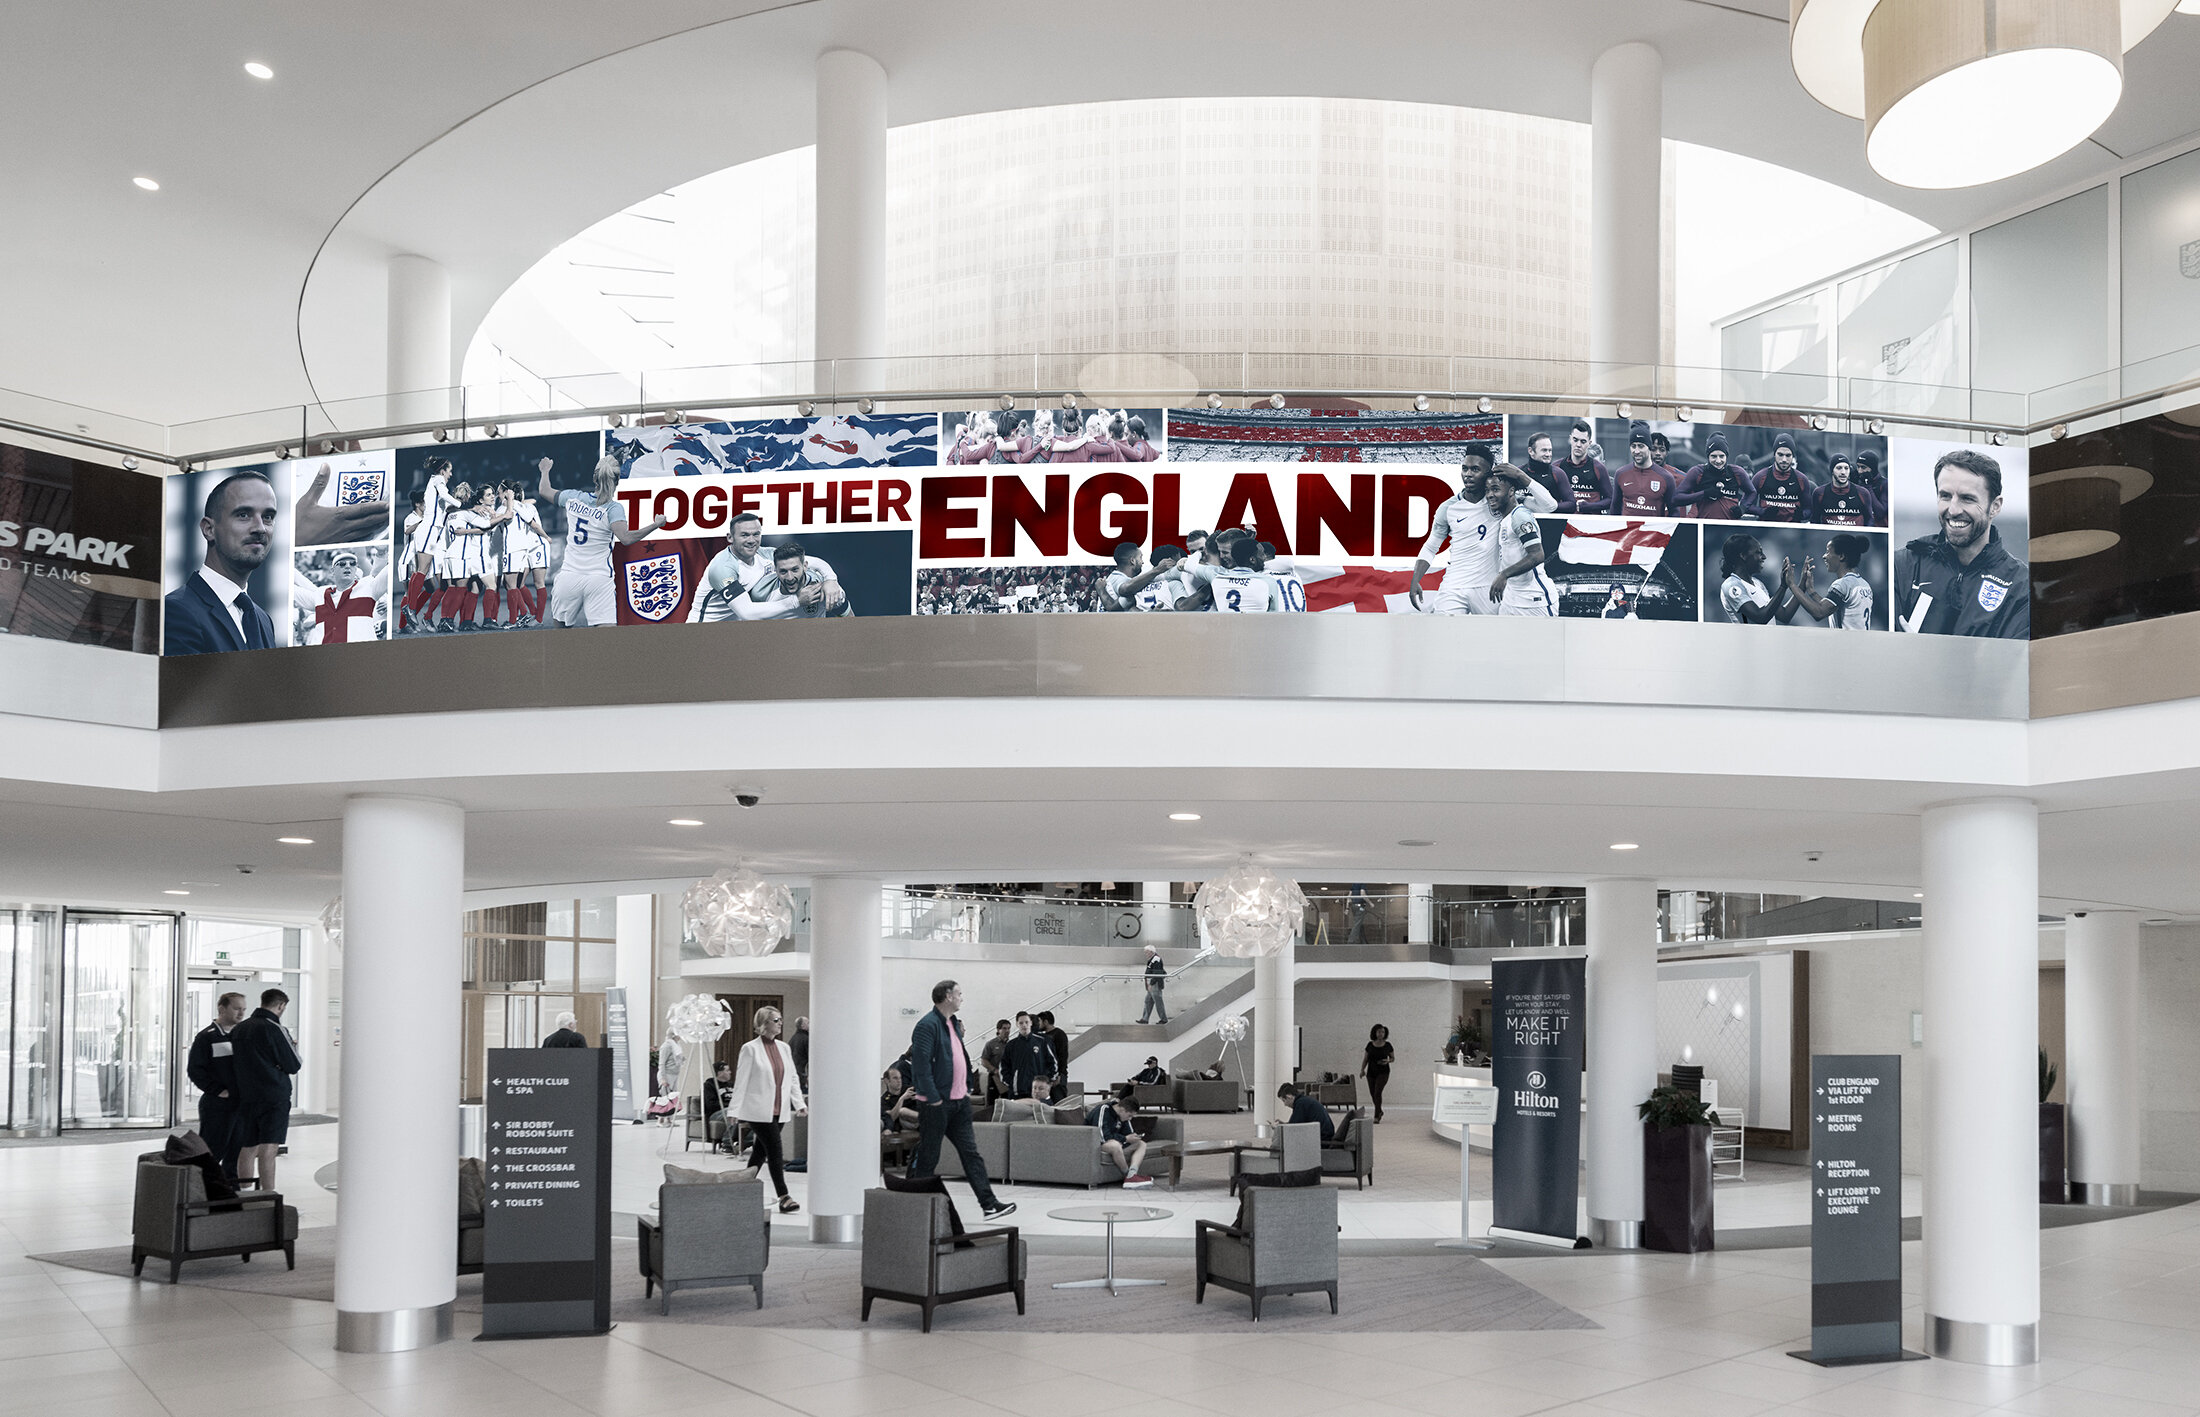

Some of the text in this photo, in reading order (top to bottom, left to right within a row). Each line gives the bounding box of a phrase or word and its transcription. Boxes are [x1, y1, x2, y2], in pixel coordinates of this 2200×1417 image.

[1626, 502, 1657, 511] VAUXHALL
[618, 472, 1454, 559] TOGETHER ENGLAND
[574, 517, 588, 545] 5
[1478, 524, 1487, 540] 9
[24, 527, 134, 569] PARK
[536, 552, 542, 561] 9
[20, 561, 92, 585] TEAMS
[723, 588, 732, 599] C
[1276, 579, 1306, 612] 10
[1034, 919, 1065, 927] CENTRE
[1036, 927, 1063, 935] CIRCLE
[1506, 1017, 1569, 1031] MAKE IT
[1515, 1031, 1560, 1045] RIGHT
[506, 1078, 570, 1086] HEALTH CLUB
[1828, 1078, 1880, 1086] CLUB ENGLAND
[506, 1087, 534, 1095] & SPA
[1828, 1086, 1872, 1095] VIA LIFT ON
[1514, 1090, 1559, 1109] Hilton
[1828, 1096, 1864, 1104] 1st FLOOR
[1828, 1114, 1863, 1123] MEETING
[506, 1121, 554, 1129] SIR BOBBY
[1828, 1124, 1857, 1132] ROOMS
[506, 1129, 575, 1138] ROBSON SUITE
[505, 1146, 568, 1155] RESTAURANT
[506, 1164, 576, 1172] THE CROSSBAR
[1828, 1160, 1856, 1169] HILTON
[1828, 1169, 1870, 1178] RECEPTION
[505, 1180, 581, 1190] PRIVATE DINING
[1828, 1186, 1881, 1197] LIFT LOBBY TO
[505, 1198, 544, 1207] TOILETS
[1828, 1197, 1870, 1206] EXECUTIVE
[1828, 1206, 1859, 1215] LOUNGE
